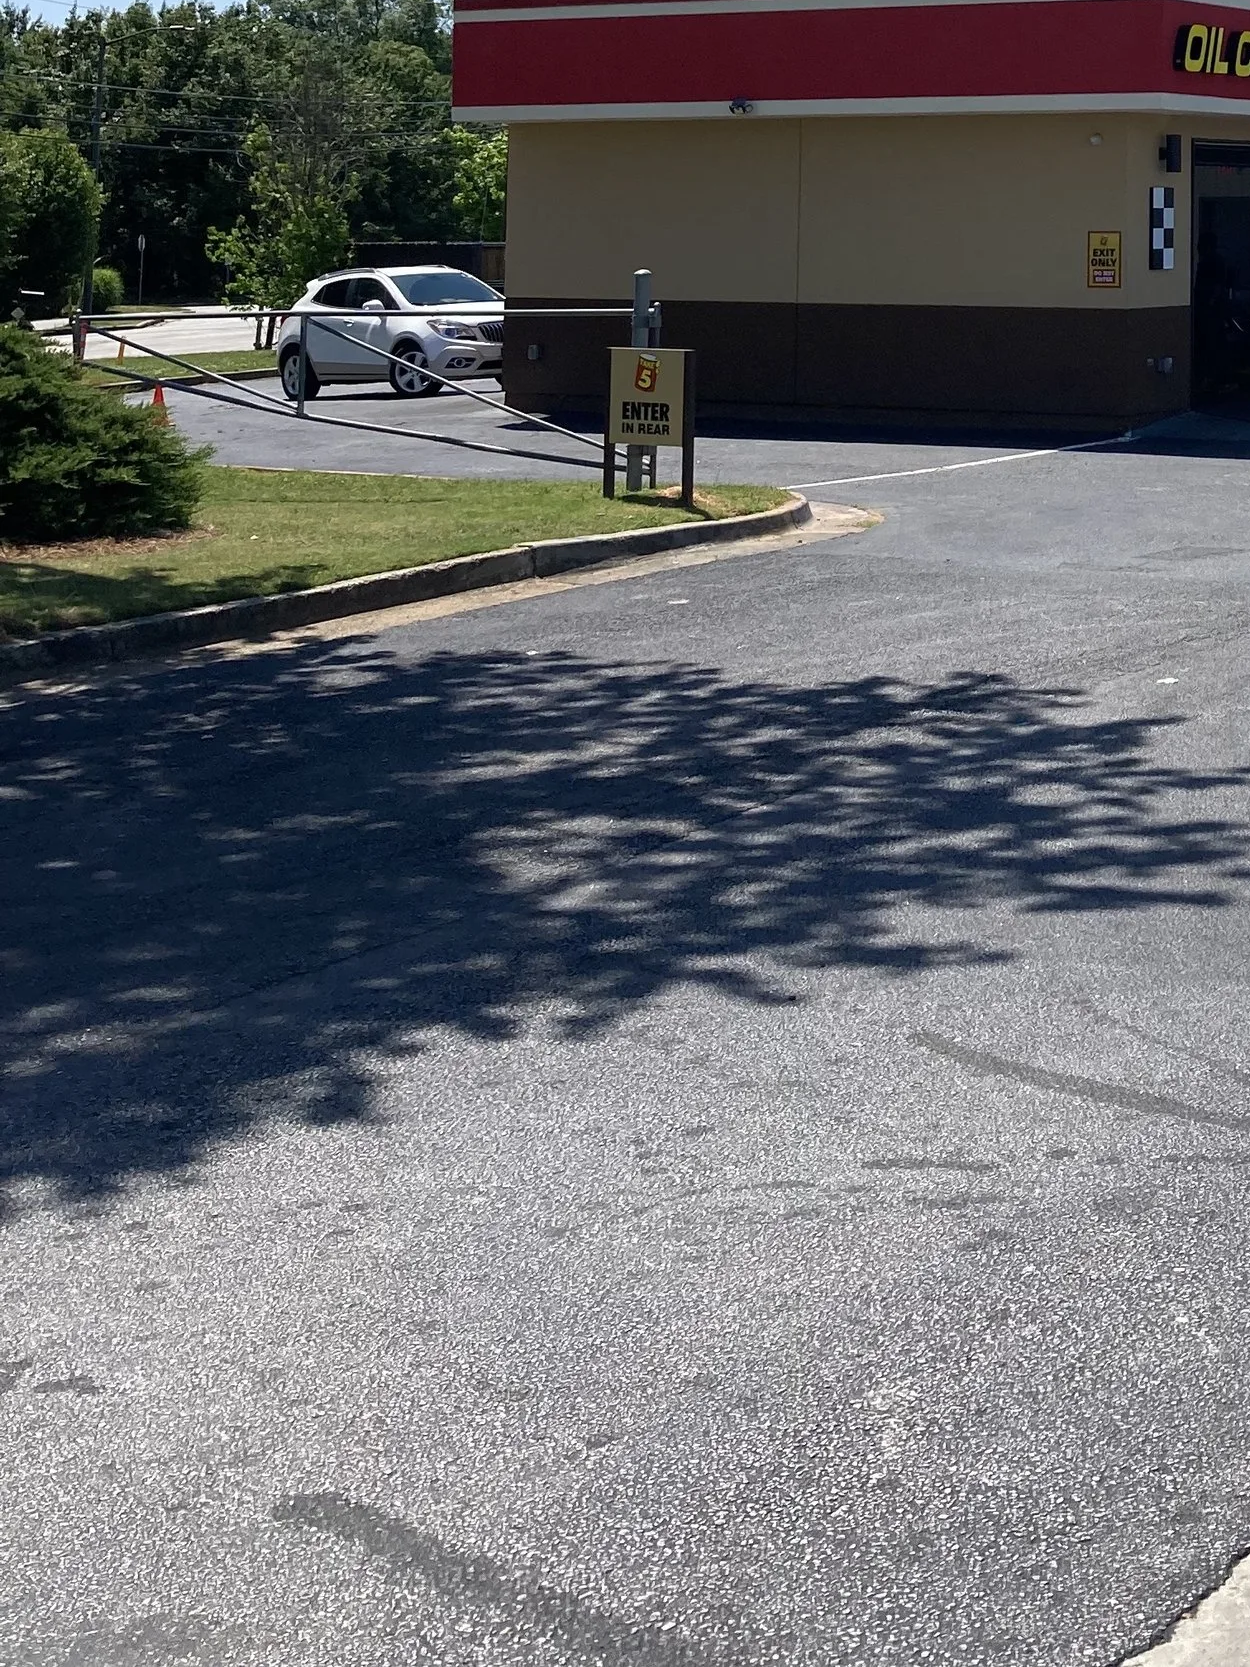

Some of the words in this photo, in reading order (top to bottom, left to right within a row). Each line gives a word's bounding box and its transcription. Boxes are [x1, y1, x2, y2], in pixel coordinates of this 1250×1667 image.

[1184, 24, 1229, 75] OIL
[1092, 248, 1116, 257] EXIT
[1091, 258, 1117, 267] ONLY
[638, 369, 652, 388] 5
[622, 401, 670, 422] ENTER
[621, 422, 634, 434] IN
[638, 423, 670, 436] REAR
